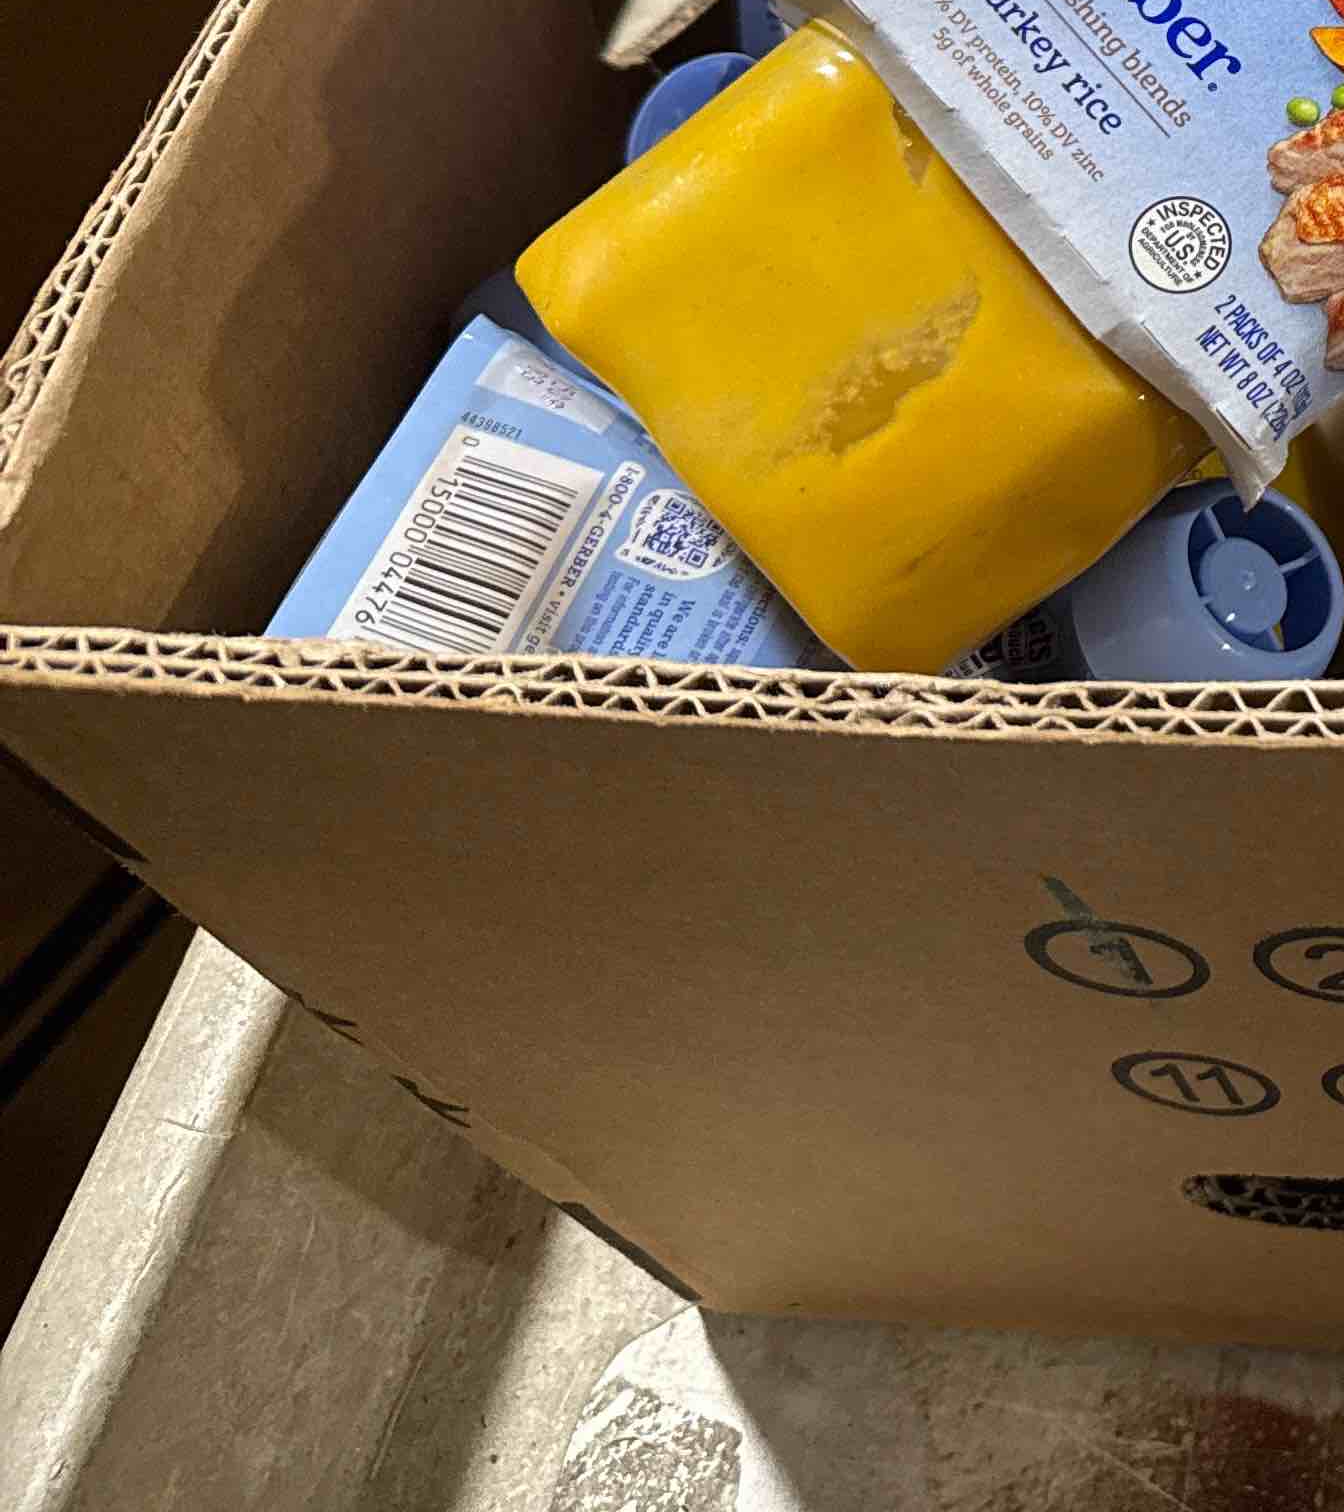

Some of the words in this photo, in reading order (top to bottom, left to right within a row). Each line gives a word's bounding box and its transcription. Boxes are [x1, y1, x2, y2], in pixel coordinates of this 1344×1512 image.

[948, 10, 978, 35] DV
[968, 35, 1023, 96] protein,
[1050, 123, 1078, 149] DV
[1072, 147, 1105, 182] zinc
[968, 65, 1011, 113] whole
[1004, 106, 1054, 161] grains
[1063, 73, 1122, 135] rice
[1123, 48, 1195, 128] blends
[1157, 202, 1225, 271] INSPECTED
[1214, 295, 1236, 314] 2
[1227, 304, 1269, 350] PACKS
[1196, 325, 1231, 357] NET
[1219, 347, 1250, 378] WT
[1237, 371, 1257, 390] 8
[1247, 382, 1273, 409] OZ
[462, 437, 480, 449] 0
[407, 477, 459, 545] 15000
[354, 549, 414, 628] 04476
